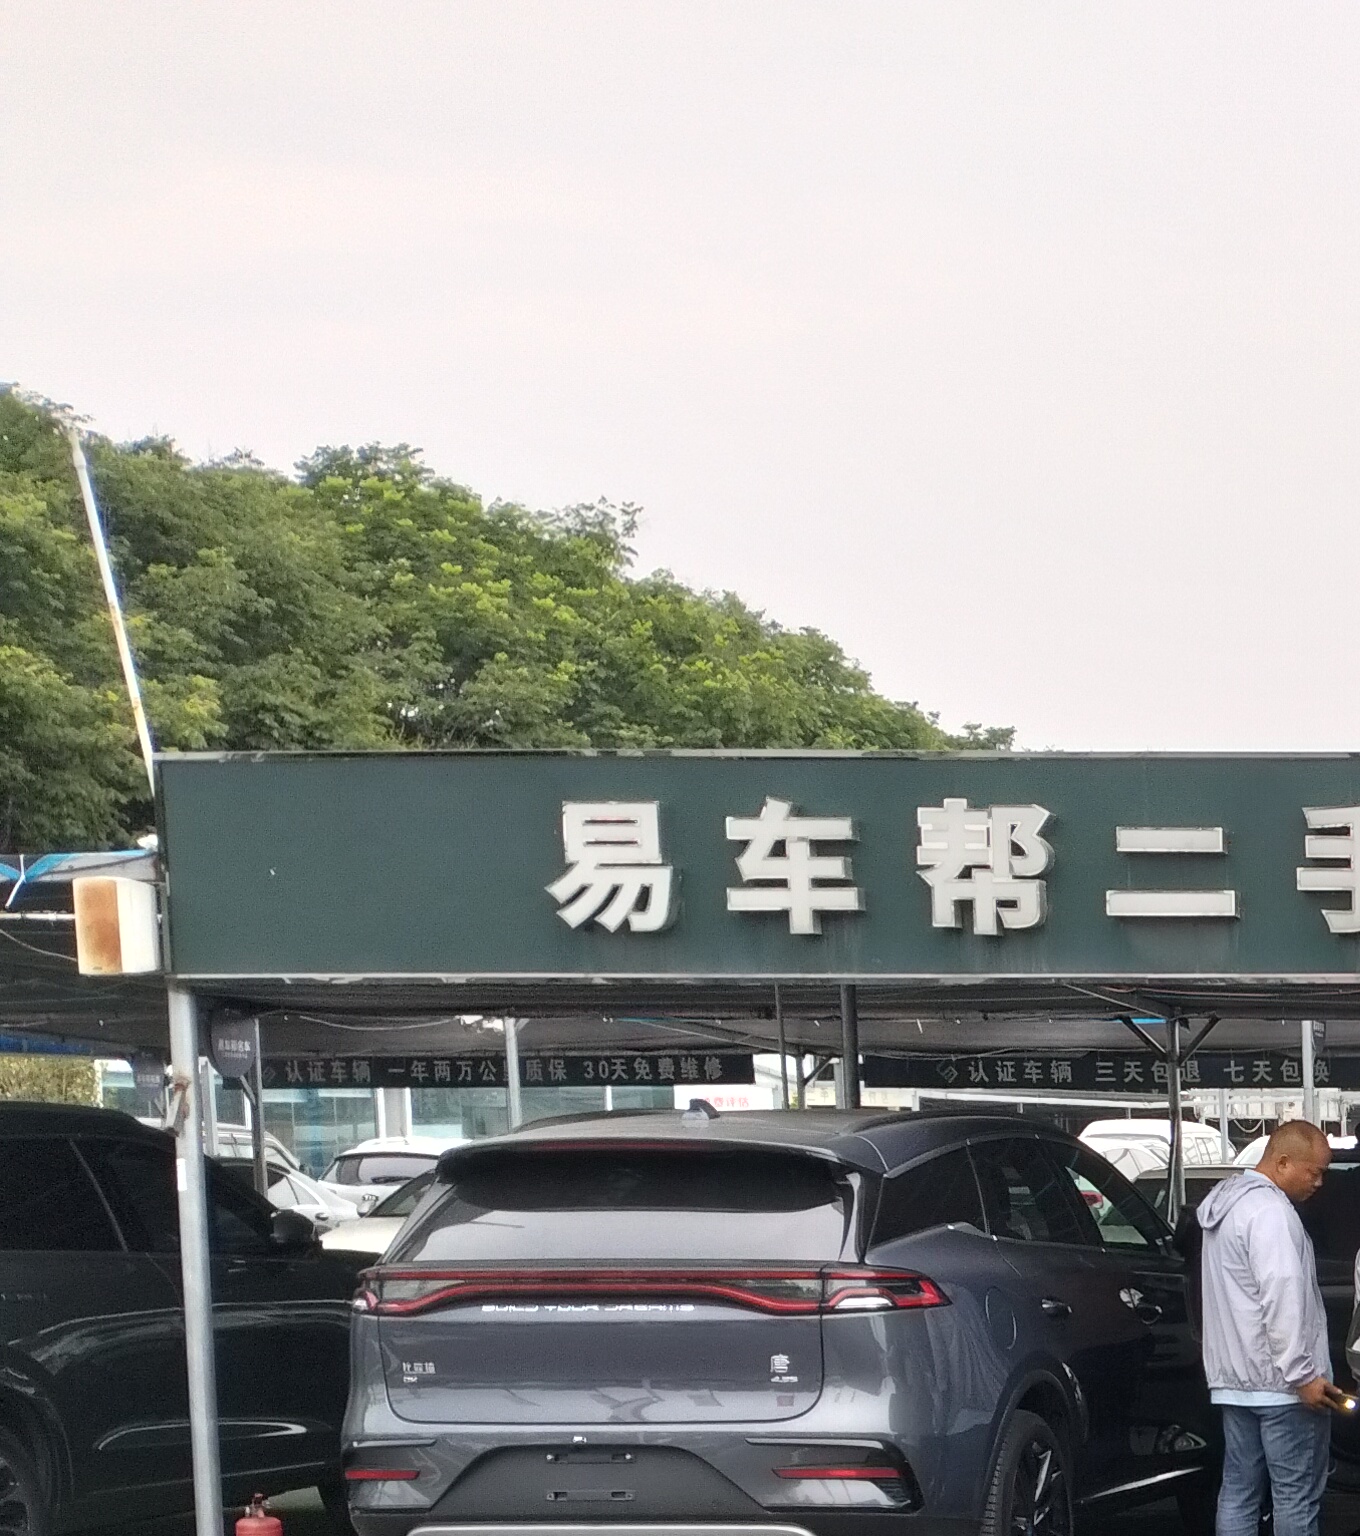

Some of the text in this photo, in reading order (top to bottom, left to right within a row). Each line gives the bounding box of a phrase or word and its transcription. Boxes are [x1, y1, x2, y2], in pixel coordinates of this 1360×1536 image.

[285, 1060, 371, 1083] 认证车辆
[583, 1058, 723, 1080] 30天免费维修
[968, 1060, 1072, 1083] 认证车辆
[1095, 1060, 1201, 1083] 三天包退
